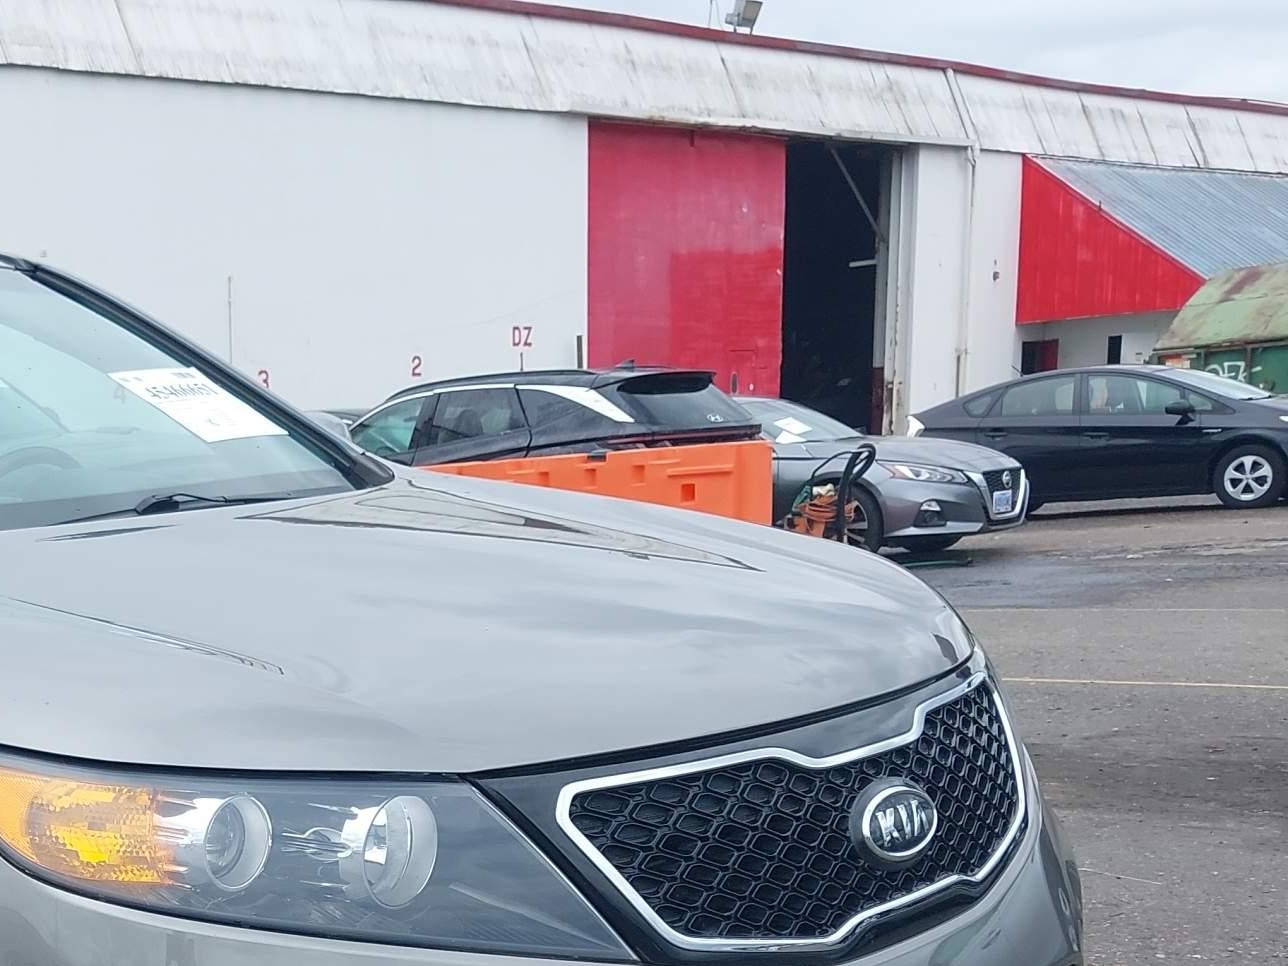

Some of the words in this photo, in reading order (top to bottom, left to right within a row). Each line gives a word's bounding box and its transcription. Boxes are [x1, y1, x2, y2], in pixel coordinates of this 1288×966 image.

[512, 326, 533, 347] DZ
[411, 355, 422, 377] 2
[258, 369, 270, 389] 3
[875, 799, 930, 848] KIA
